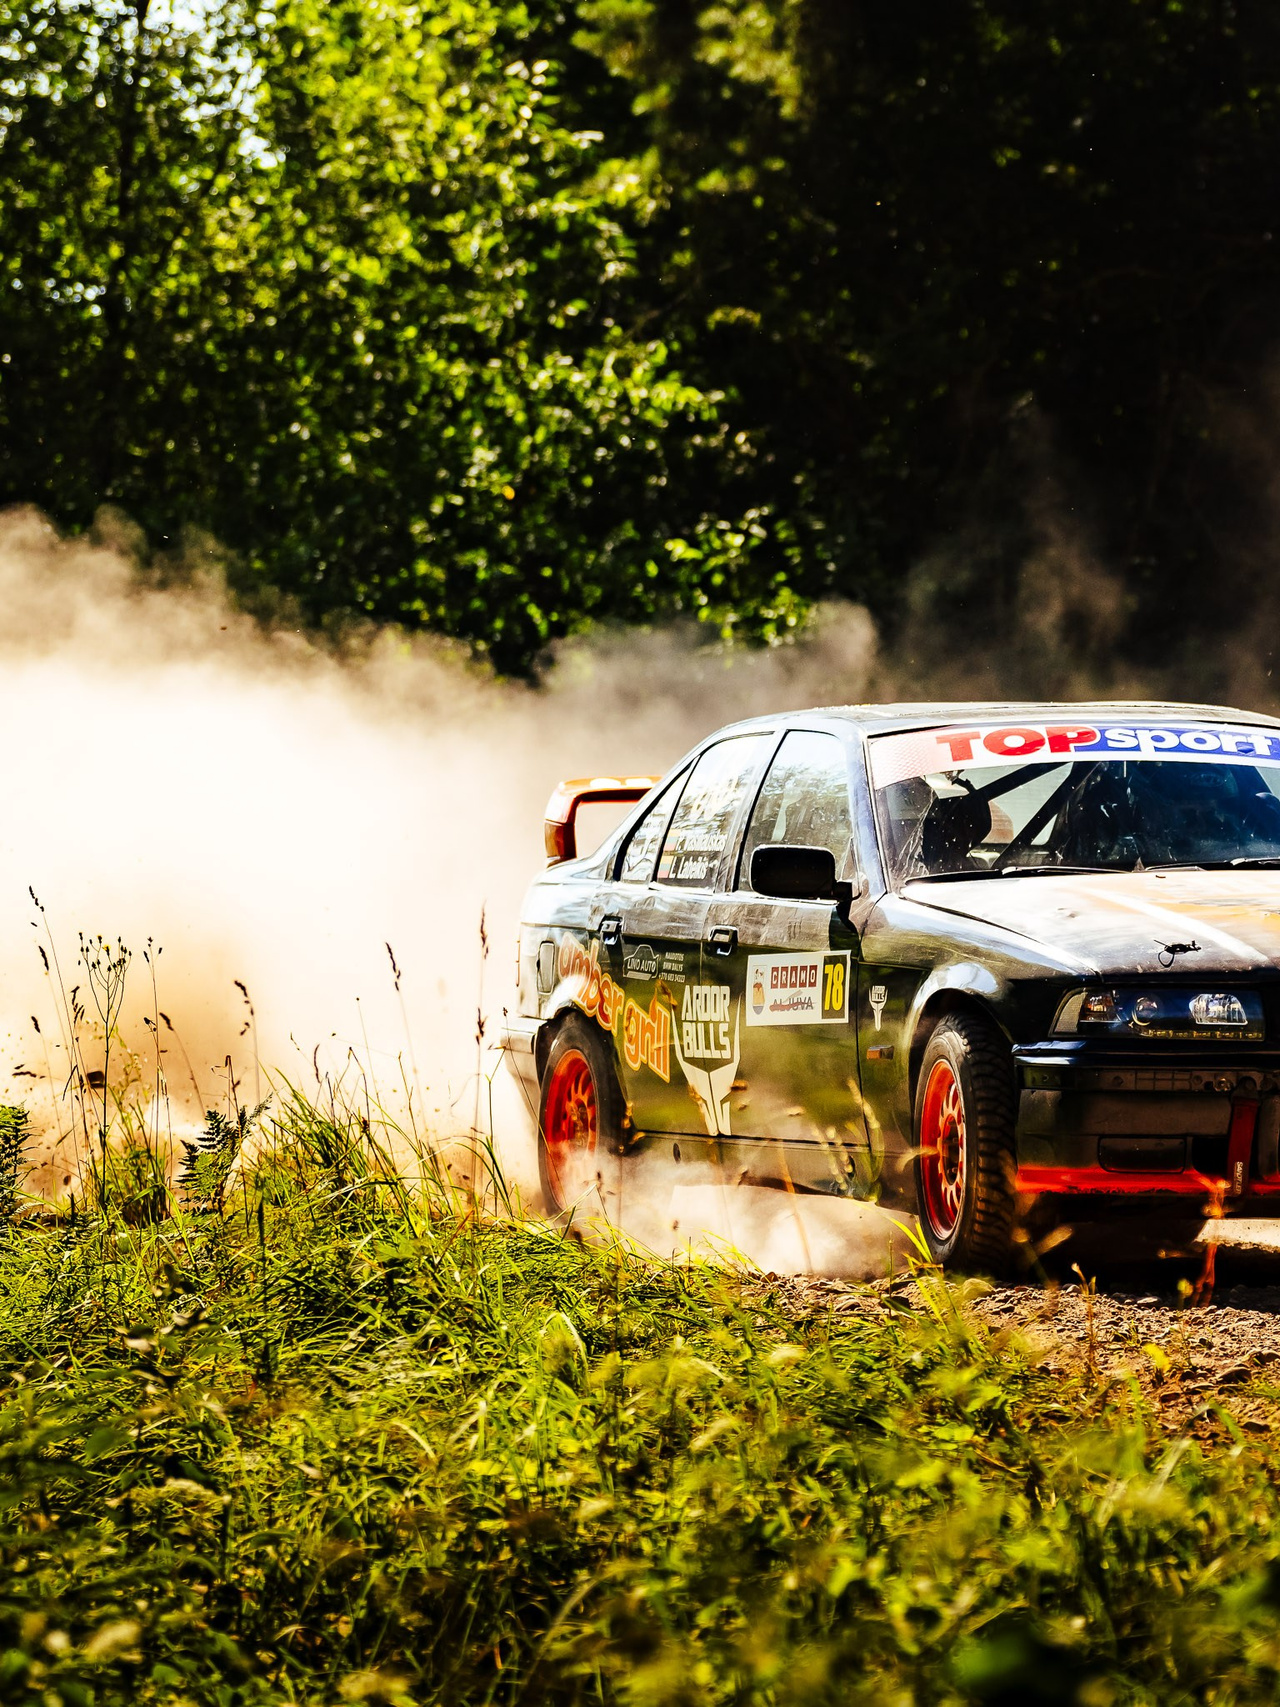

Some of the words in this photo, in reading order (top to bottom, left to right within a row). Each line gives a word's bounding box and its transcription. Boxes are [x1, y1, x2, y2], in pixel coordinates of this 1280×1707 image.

[627, 958, 641, 970] LINO
[641, 960, 656, 973] AUTO
[771, 968, 817, 986] CRAMO
[682, 986, 730, 1022] ARDOR
[824, 963, 844, 1011] 78
[683, 1022, 731, 1059] BULLS
